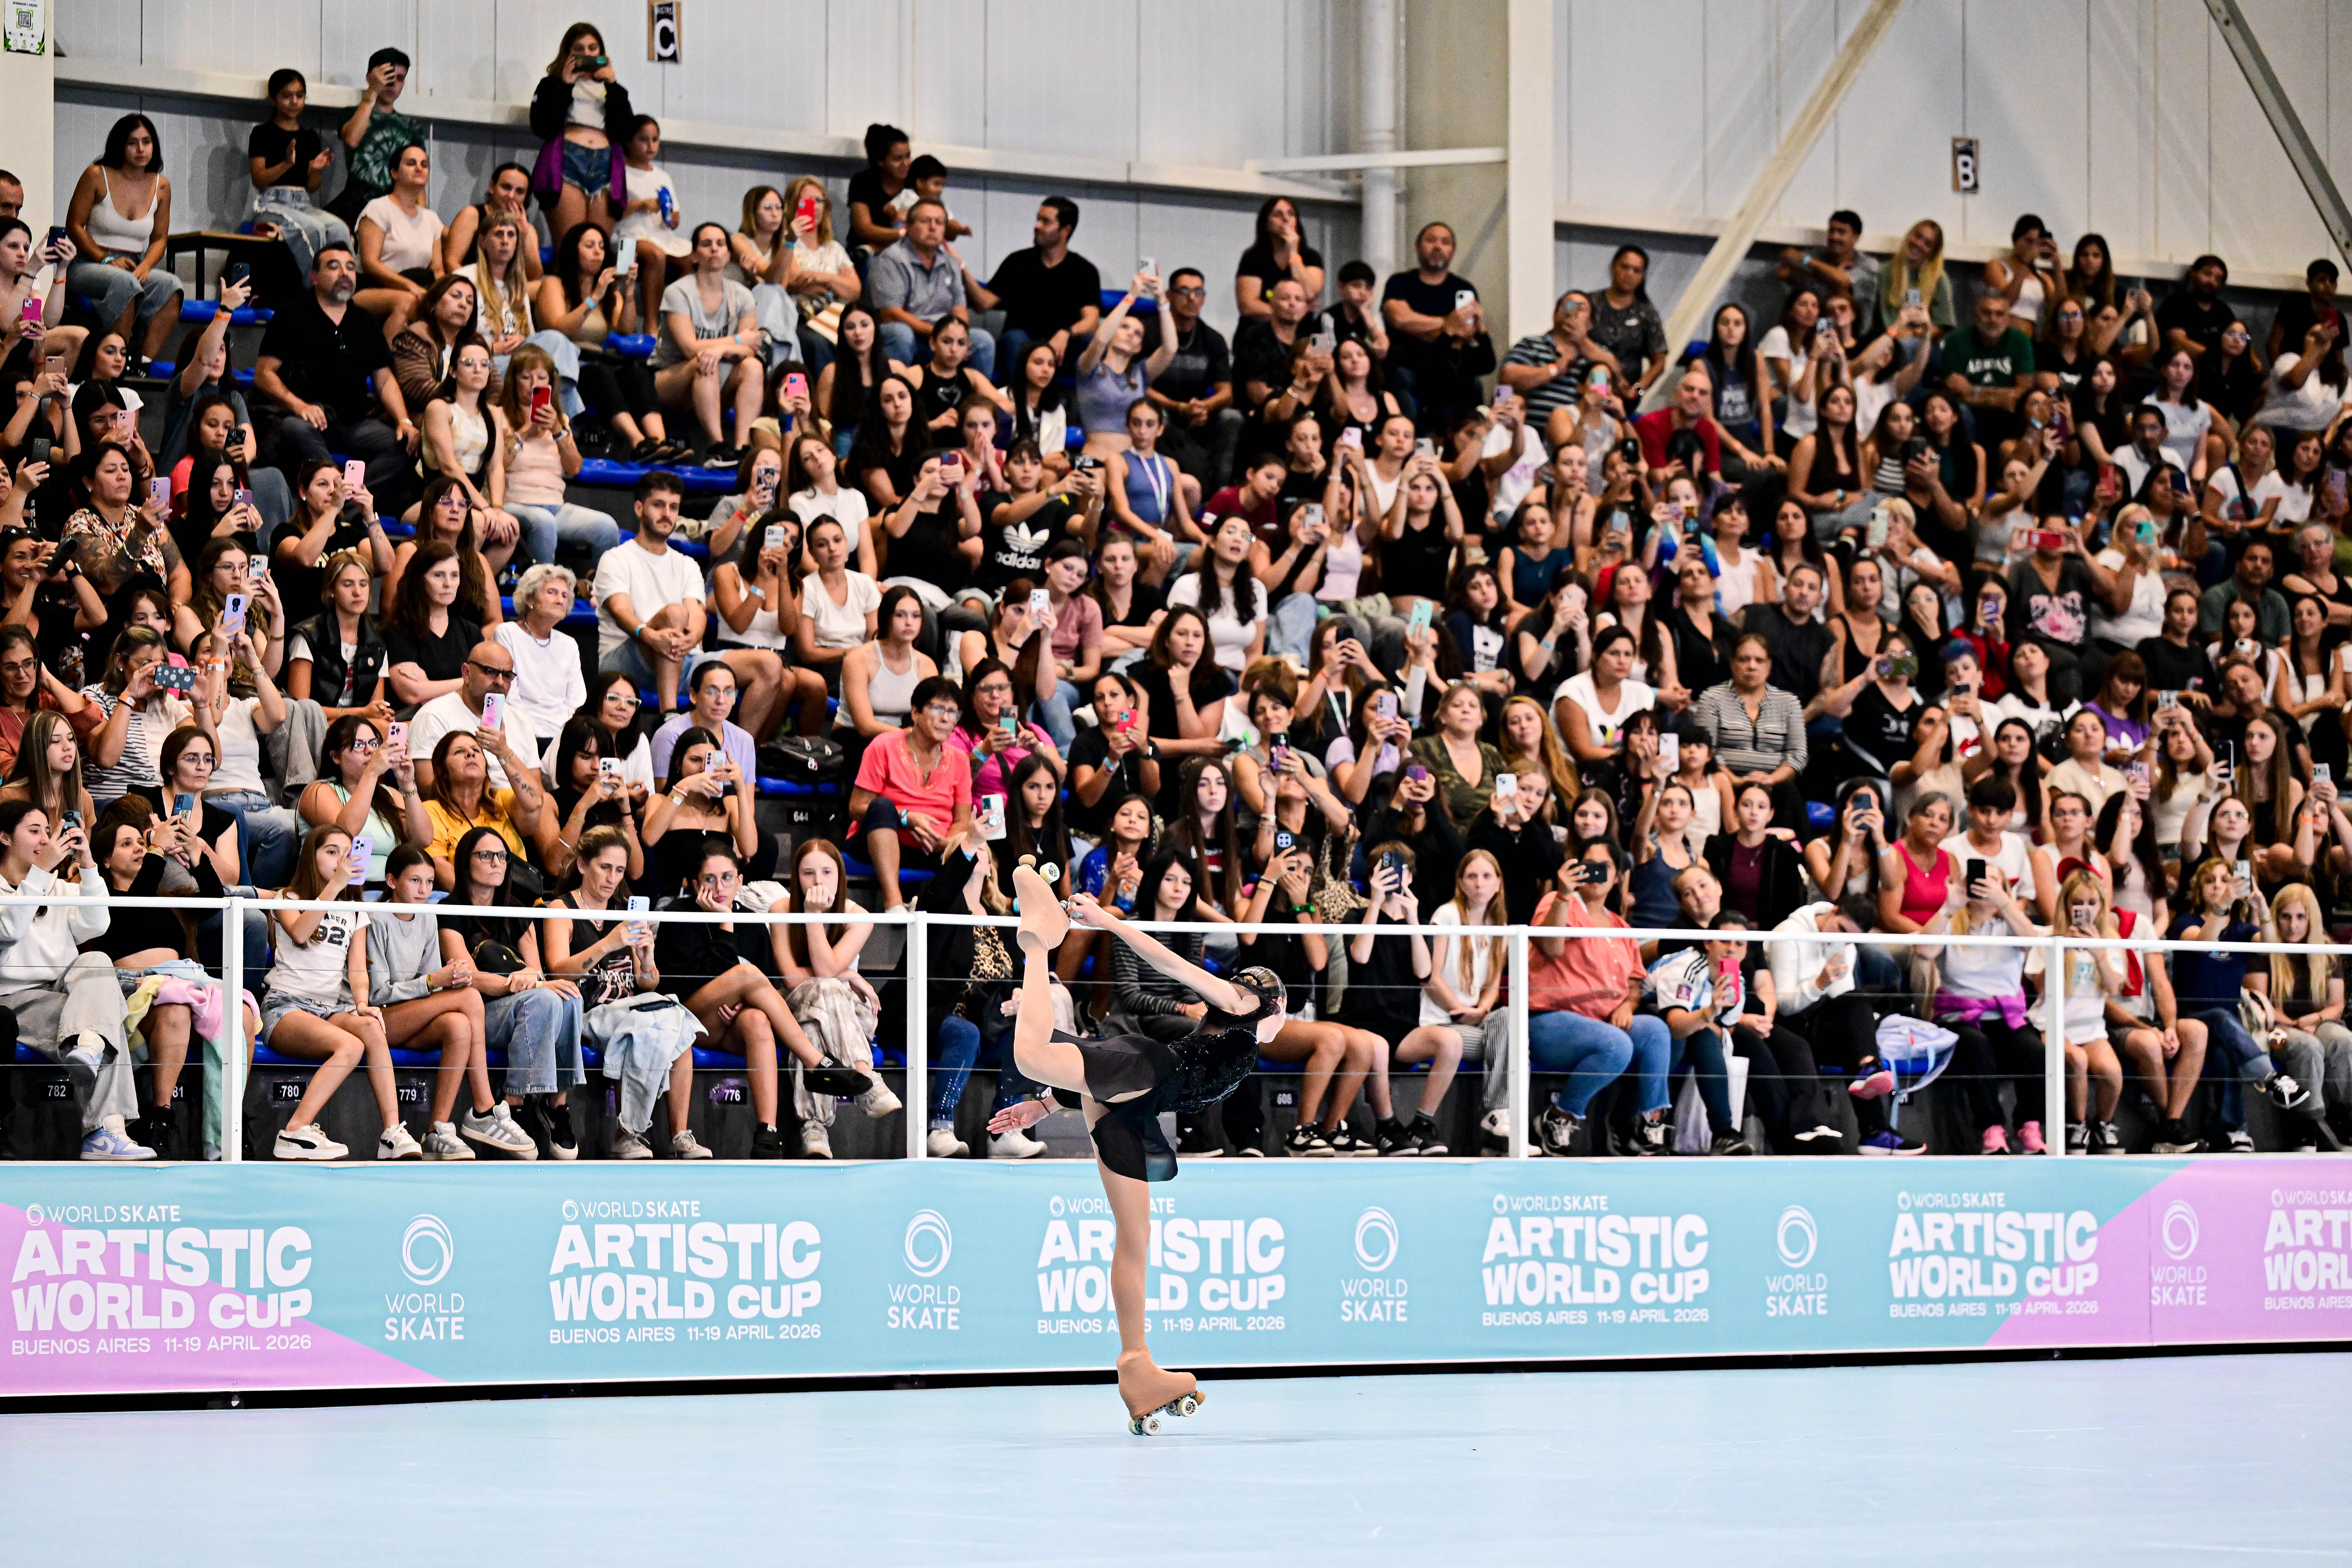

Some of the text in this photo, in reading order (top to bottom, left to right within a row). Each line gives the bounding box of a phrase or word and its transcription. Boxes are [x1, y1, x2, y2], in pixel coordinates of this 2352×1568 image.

[655, 18, 675, 58] C
[1957, 155, 1975, 188] B
[48, 1085, 66, 1097] 782
[172, 1086, 183, 1098] 81
[281, 1085, 299, 1097] 780
[399, 1089, 417, 1101] 779
[724, 1089, 740, 1102] 776
[1067, 1198, 1110, 1214] WORL
[1510, 1195, 1609, 1211] WORLD SKATE
[1912, 1192, 2005, 1207] WORLD SKATE
[2285, 1190, 2328, 1205] WORLD
[47, 1205, 181, 1223] WORLD SKATE
[581, 1200, 701, 1218] WORLD SKATE
[1482, 1214, 1708, 1268] ARTISTIC
[1890, 1210, 2098, 1263] ARTISTIC
[2264, 1210, 2352, 1252] ART
[549, 1220, 821, 1280] ARTISTIC
[1038, 1218, 1285, 1274] ARISTIC
[11, 1226, 312, 1288] ARTISTIC
[1482, 1261, 1709, 1305] WORLD CUP
[1766, 1273, 1827, 1293] WORLD
[1890, 1255, 2098, 1298] WORLD CUP
[2151, 1266, 2207, 1284] WORLD
[549, 1272, 821, 1321] WORLD CUP
[888, 1284, 960, 1305] WORLD
[1037, 1266, 1285, 1313] WOD CUP
[1341, 1278, 1408, 1298] WORLD
[2151, 1285, 2207, 1306] SKATE
[11, 1280, 312, 1332] WORLD CUP
[385, 1293, 464, 1314] WORLD
[1341, 1300, 1408, 1322] SKATE
[1766, 1293, 1828, 1317] SKATE
[1890, 1300, 2098, 1317] BUENOS AIRES 11-19 APRIL 2026
[2264, 1296, 2315, 1310] BUENOS
[887, 1306, 960, 1330] SKATE
[1037, 1318, 1102, 1334] BUENOS
[1162, 1317, 1194, 1331] 11-19
[1198, 1317, 1243, 1331] APRIL
[1247, 1316, 1285, 1330] 2026
[1482, 1308, 1709, 1326] BUENOS AIRES 11-19 APRIL 2026
[385, 1317, 464, 1341] SKATE
[550, 1324, 821, 1344] BUENOS AIRES 11-19 APRIL 2026
[12, 1334, 311, 1355] BUENOS AIRES 11-19 APRIL 2026
